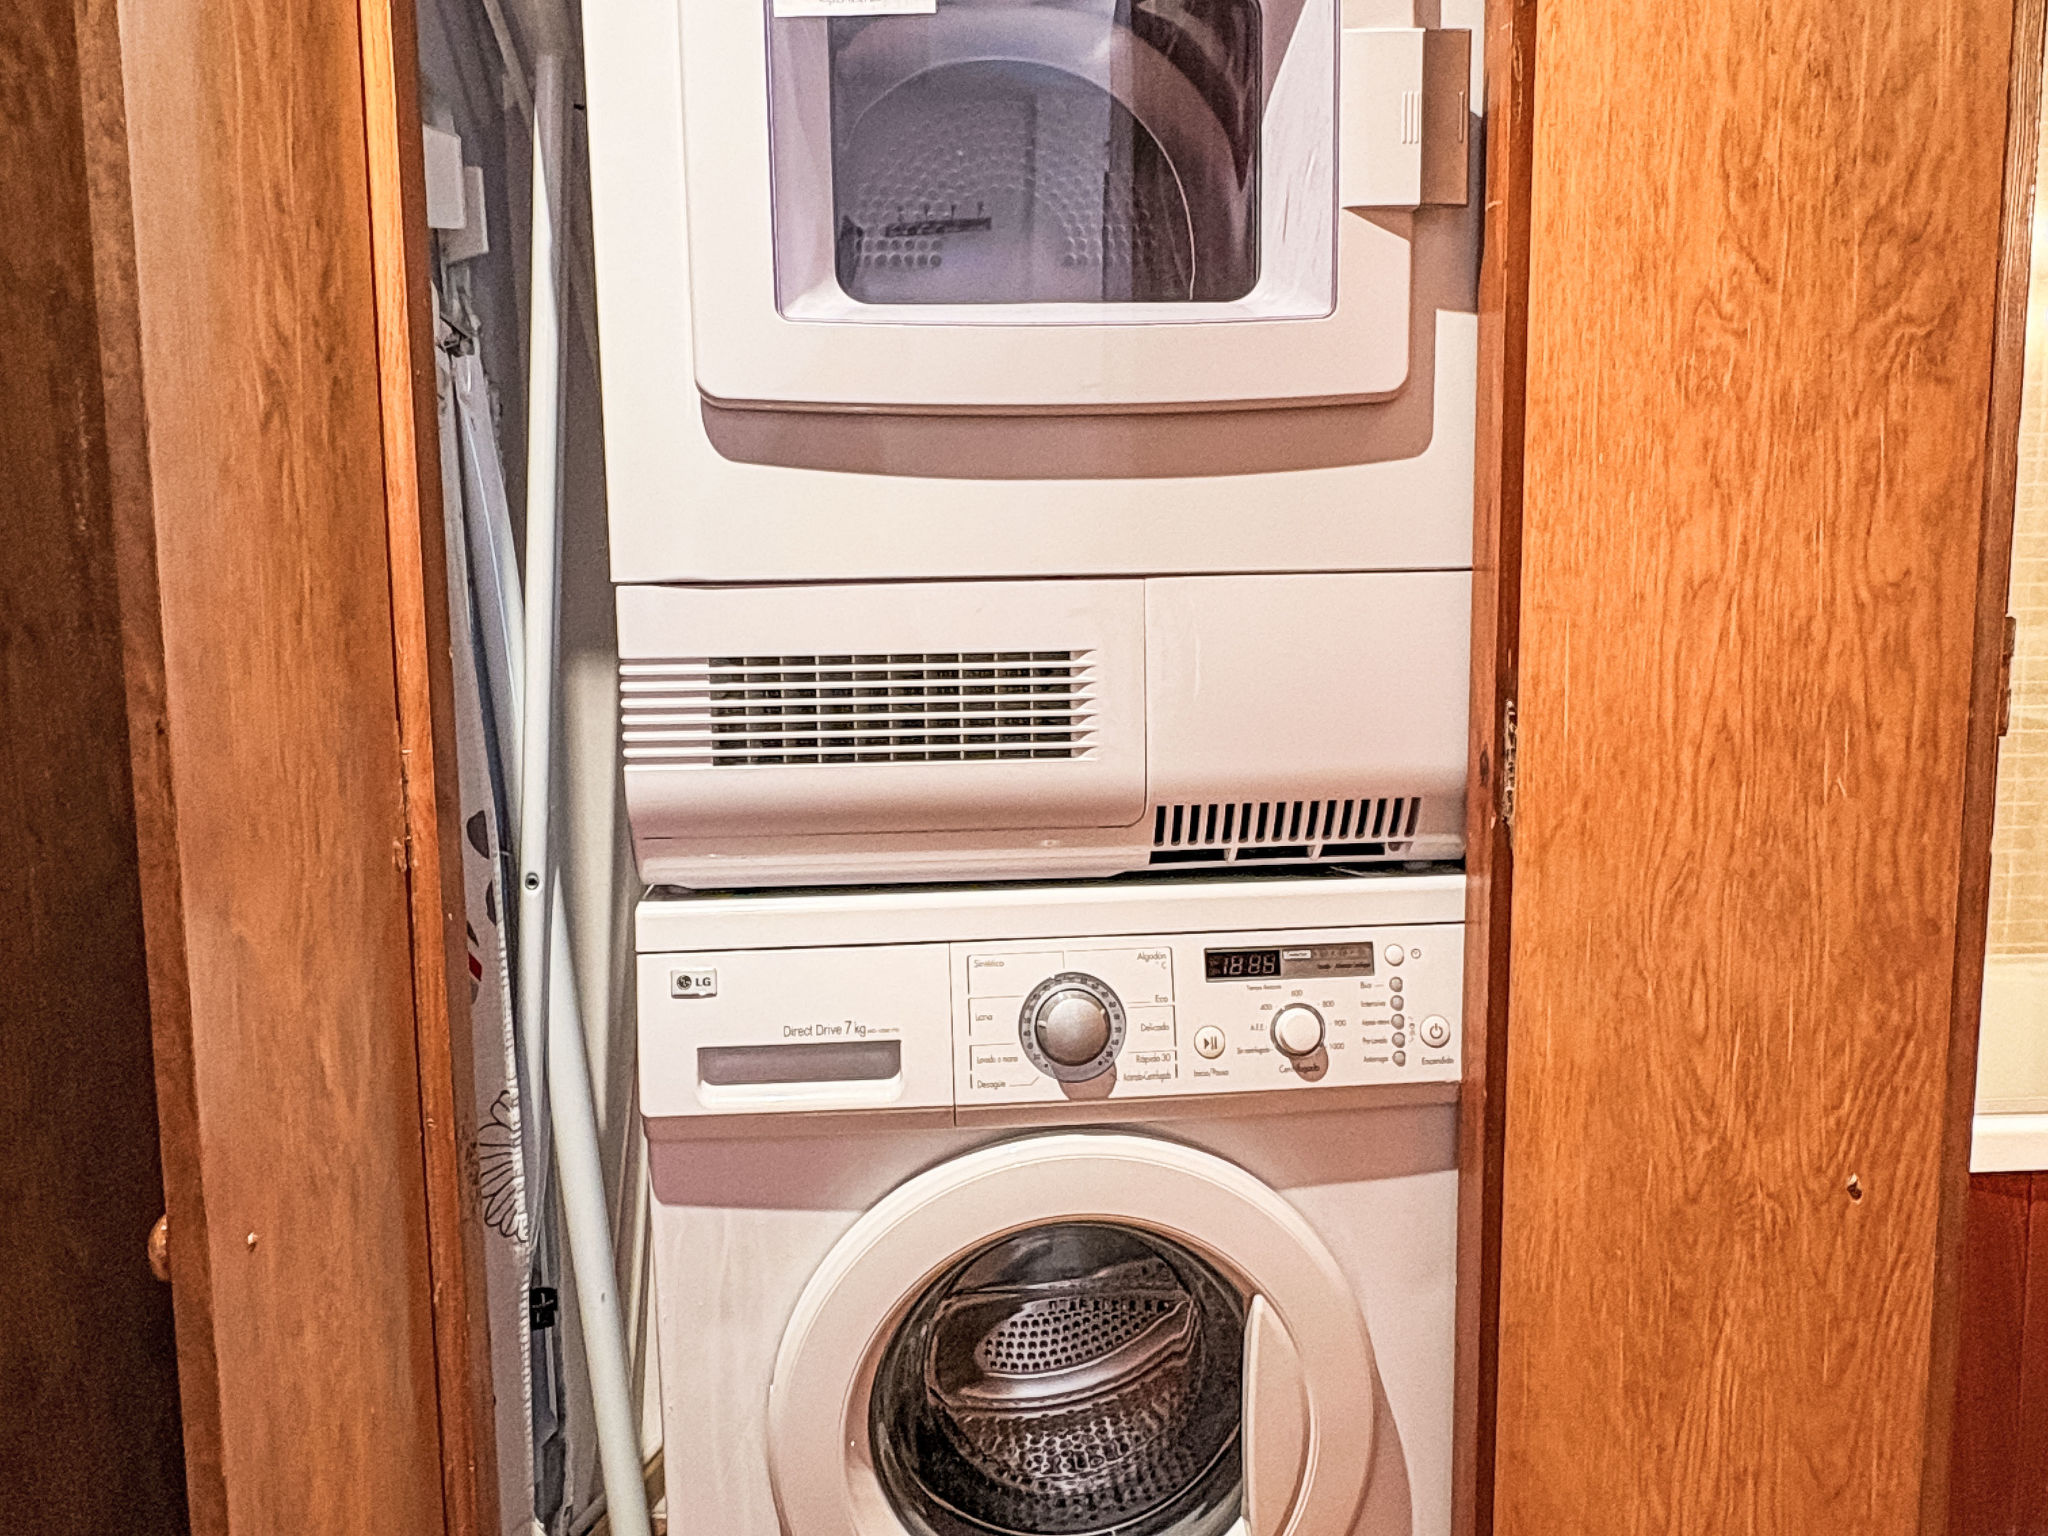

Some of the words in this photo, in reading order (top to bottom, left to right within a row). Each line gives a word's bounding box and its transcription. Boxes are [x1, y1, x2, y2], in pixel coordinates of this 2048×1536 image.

[695, 976, 712, 987] LG
[783, 1025, 813, 1038] Direct
[815, 1024, 843, 1036] Drive
[844, 1020, 852, 1035] 7
[854, 1022, 867, 1037] kg
